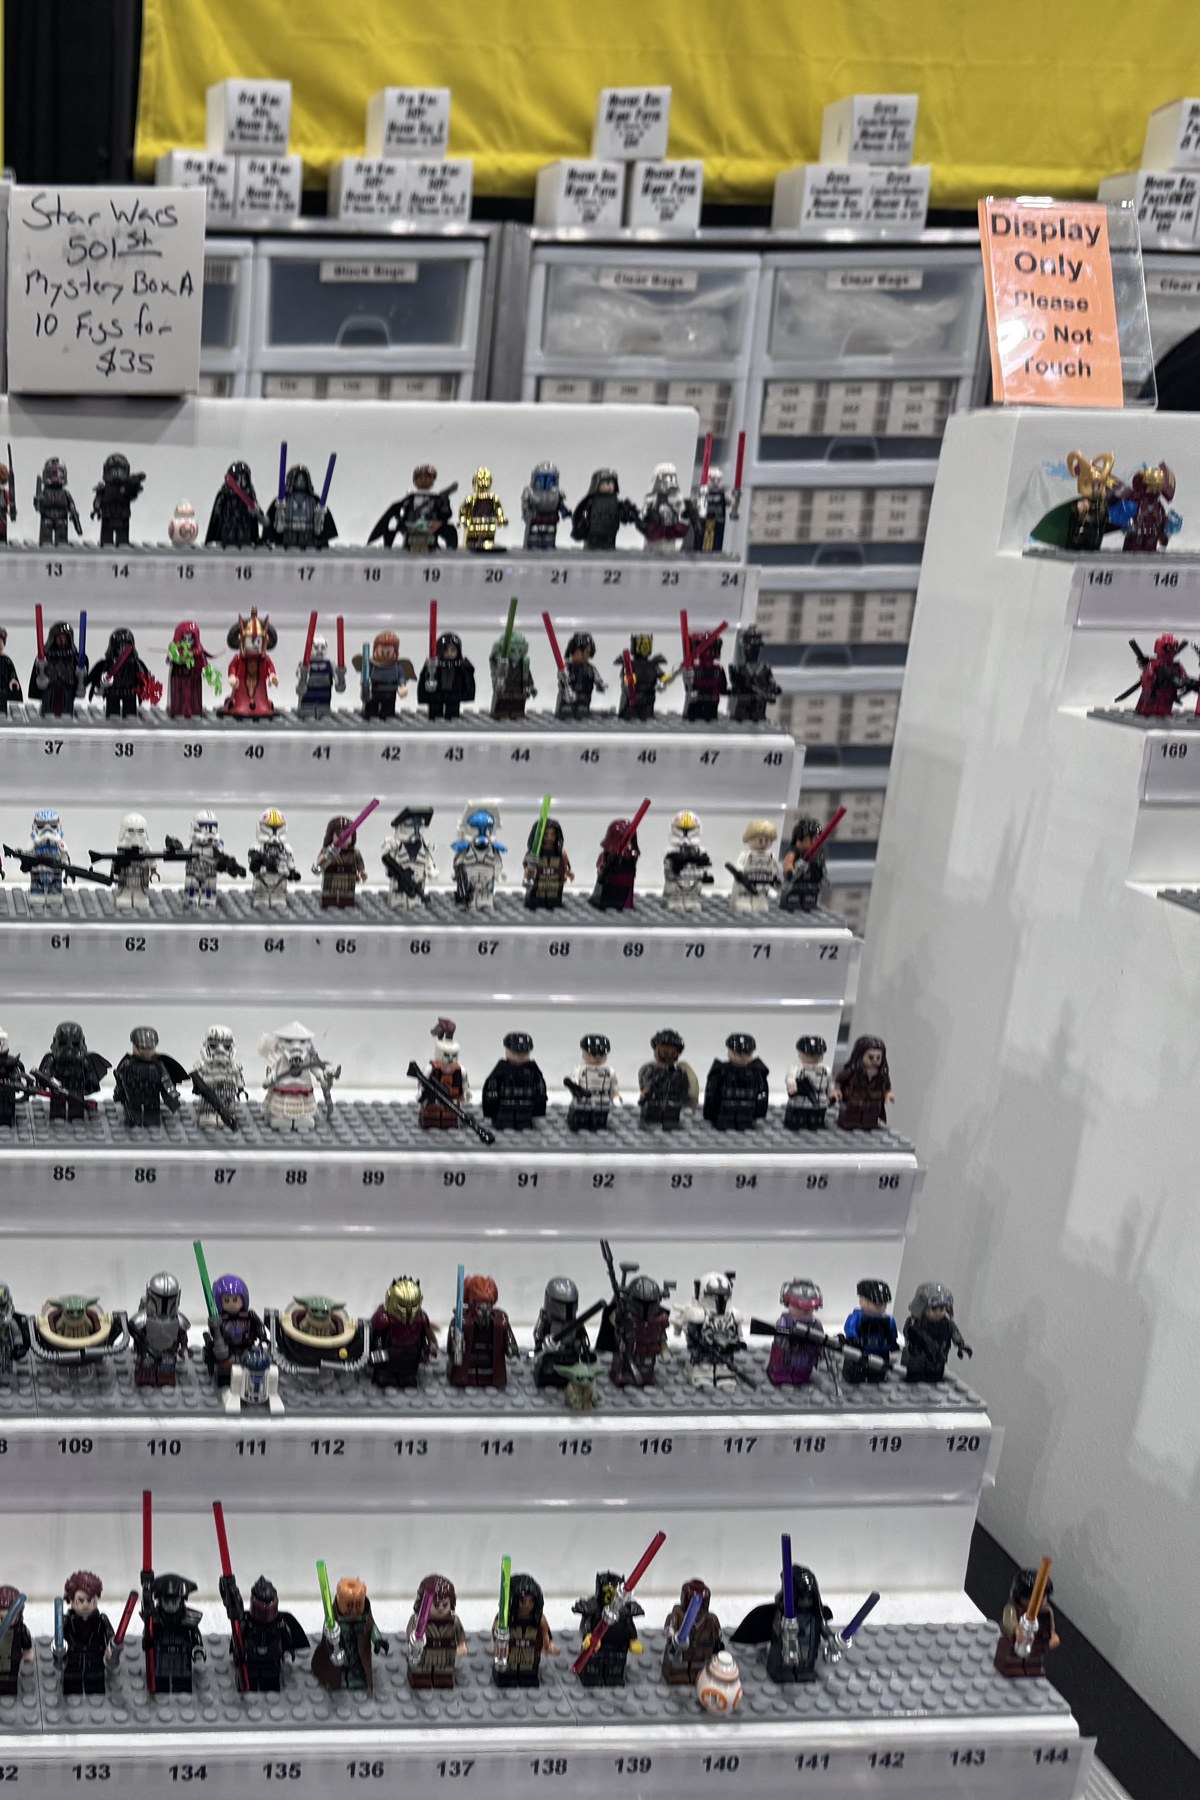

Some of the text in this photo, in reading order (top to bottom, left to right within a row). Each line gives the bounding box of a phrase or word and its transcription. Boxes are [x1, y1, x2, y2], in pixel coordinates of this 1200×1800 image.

[22, 192, 178, 231] Star Wars
[991, 213, 1101, 247] Display
[1014, 251, 1083, 283] Only
[26, 267, 124, 309] Mystery
[1014, 290, 1089, 313] Please
[36, 312, 58, 338] 10
[134, 302, 172, 337] for
[1054, 325, 1093, 344] Not
[96, 346, 155, 378] $35
[45, 562, 63, 577] 13
[177, 564, 195, 580] 15
[298, 566, 315, 581] 17
[363, 567, 381, 582] 18
[485, 568, 504, 583] 20
[550, 569, 568, 584] 21
[661, 571, 680, 586] 23
[721, 572, 739, 587] 24
[44, 740, 64, 755] 37
[183, 743, 203, 759] 39
[312, 745, 331, 761] 41
[380, 745, 401, 761] 42
[510, 747, 531, 763] 44
[579, 748, 600, 764] 45
[699, 750, 721, 765] 47
[763, 751, 783, 767] 48
[50, 934, 70, 950] 61
[198, 937, 219, 953] 63
[335, 938, 357, 954] 65
[409, 939, 431, 955] 66
[548, 941, 571, 957] 68
[622, 941, 645, 958] 69
[752, 943, 771, 959] 71
[819, 944, 839, 961] 72
[52, 1165, 76, 1182] 85
[213, 1168, 237, 1185] 87
[362, 1170, 385, 1186] 89
[443, 1170, 466, 1187] 90
[592, 1172, 616, 1189] 92
[670, 1173, 693, 1190] 93
[806, 1174, 829, 1190] 95
[878, 1173, 901, 1190] 96
[57, 1437, 94, 1455] 109
[235, 1438, 267, 1456] 111
[393, 1439, 428, 1456] 113
[480, 1439, 515, 1456] 114
[639, 1437, 673, 1456] 116
[723, 1436, 758, 1454] 117
[869, 1434, 903, 1453] 119
[946, 1434, 981, 1452] 120
[72, 1763, 111, 1781] 133
[262, 1761, 302, 1780] 135
[436, 1759, 476, 1778] 137
[530, 1757, 568, 1776] 138
[702, 1755, 740, 1773] 140
[794, 1752, 831, 1771] 141
[950, 1748, 986, 1767] 143
[1033, 1747, 1070, 1765] 144
